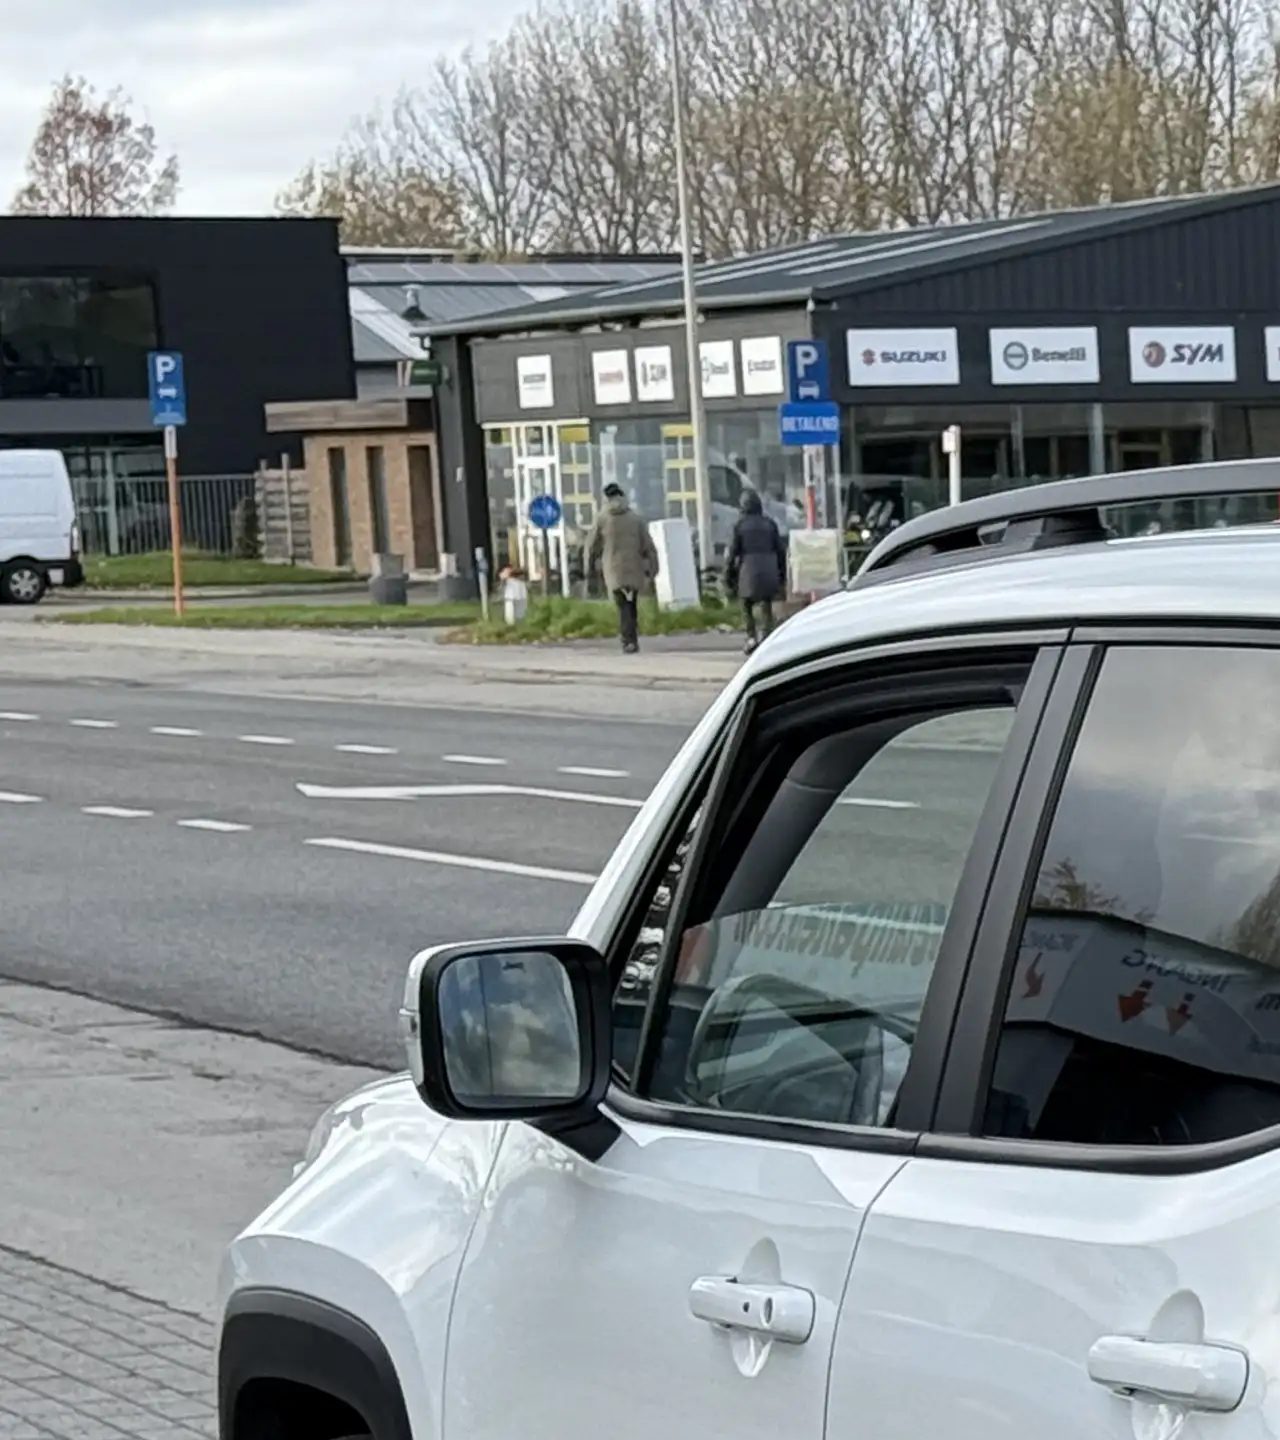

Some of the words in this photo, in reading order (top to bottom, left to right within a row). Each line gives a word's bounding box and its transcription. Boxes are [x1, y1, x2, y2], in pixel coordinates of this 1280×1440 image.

[795, 345, 819, 379] P
[880, 350, 947, 363] SUZUKI
[1031, 347, 1086, 363] Benelli
[1170, 343, 1225, 365] SYM
[156, 355, 176, 383] P
